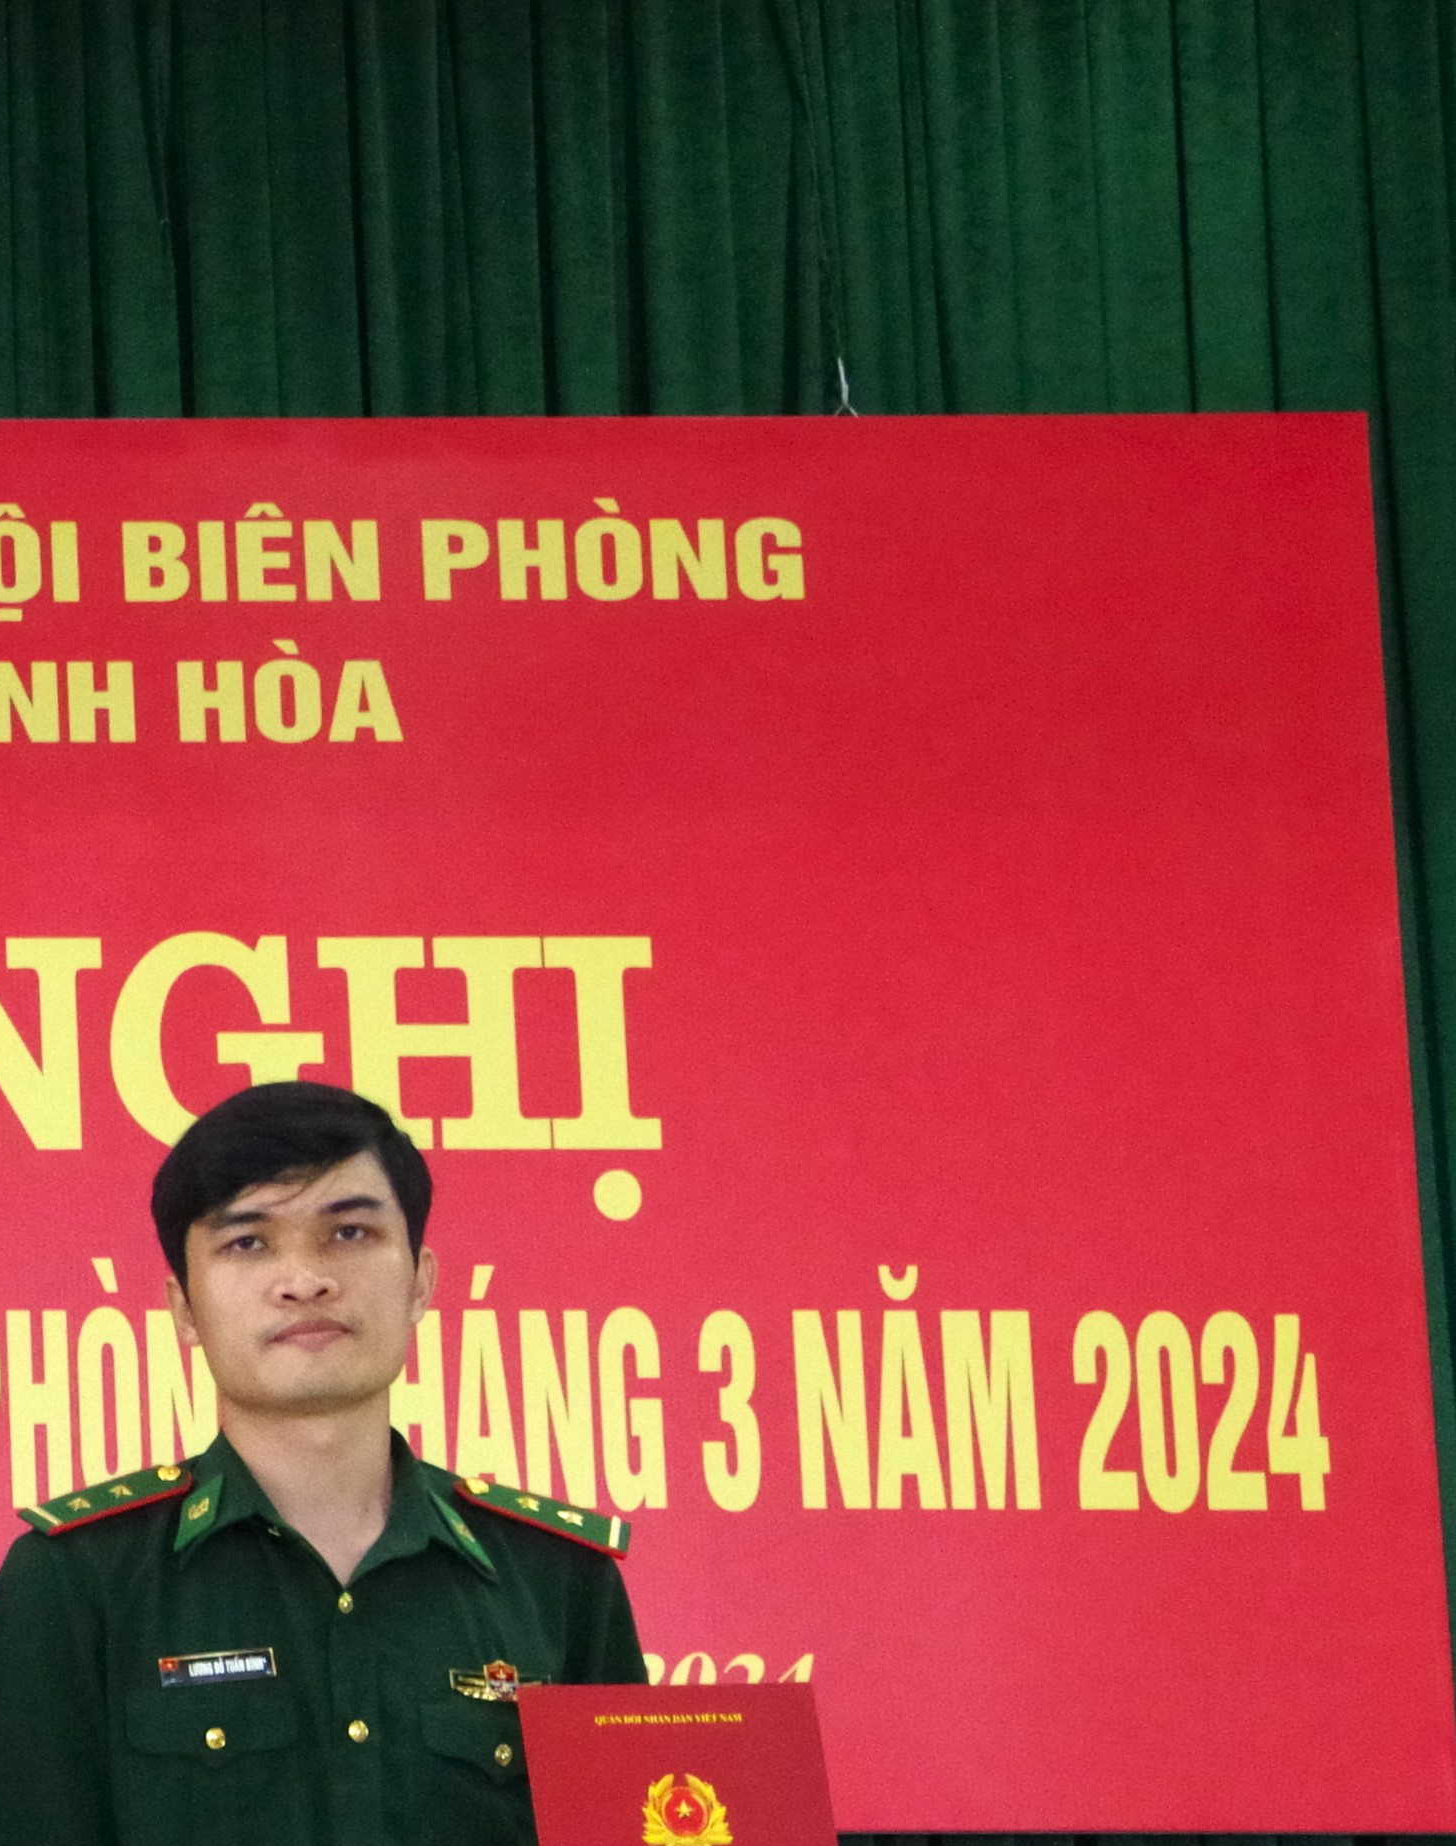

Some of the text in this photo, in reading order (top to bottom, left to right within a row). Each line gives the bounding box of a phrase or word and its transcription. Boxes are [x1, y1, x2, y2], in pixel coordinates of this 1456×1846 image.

[122, 502, 381, 602] BIÊN
[421, 498, 805, 601] PHÒNG
[177, 639, 403, 744] HÒA
[389, 1264, 668, 1513] HÁNG
[698, 1309, 762, 1512] 3
[792, 1264, 1042, 1510] NĂM
[1072, 1310, 1331, 1514] 2024
